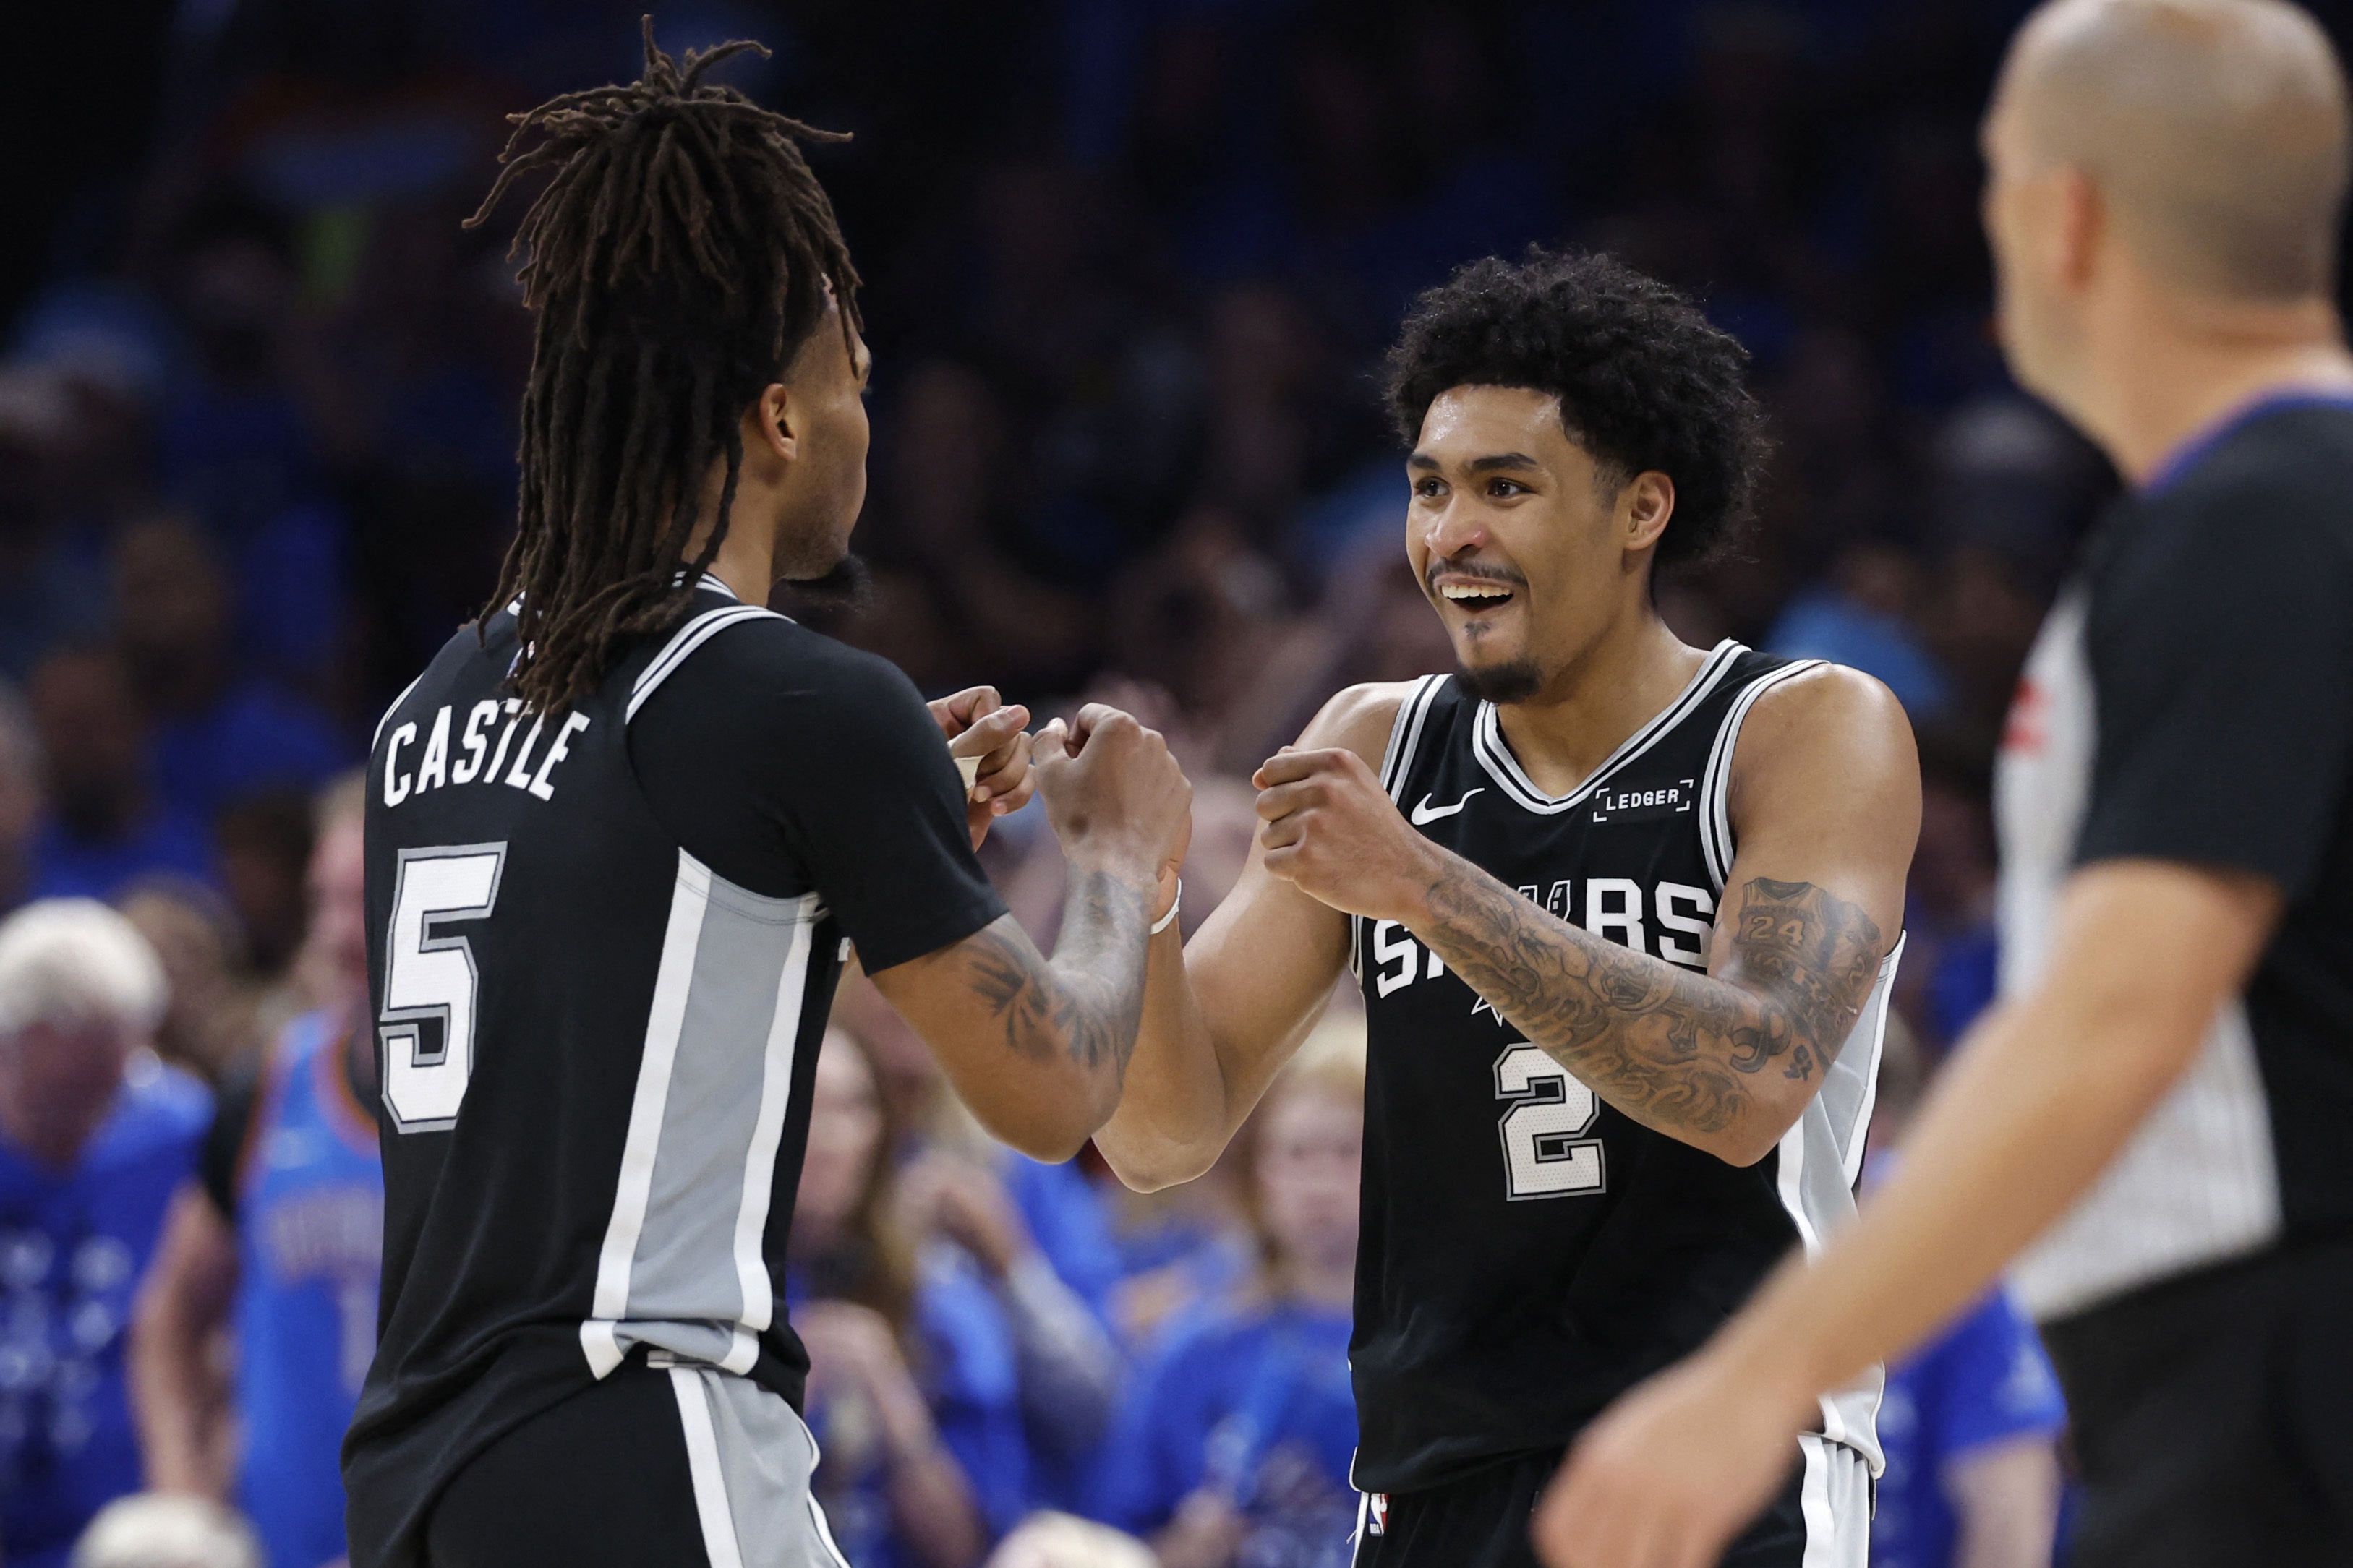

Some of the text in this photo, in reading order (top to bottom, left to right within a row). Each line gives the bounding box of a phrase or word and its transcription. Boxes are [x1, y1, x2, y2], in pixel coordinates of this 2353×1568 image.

[384, 698, 591, 807] CASTLE
[1606, 789, 1679, 810] LEDGER
[380, 841, 507, 1134] 5
[1373, 878, 1715, 998] SRS
[1750, 916, 1805, 946] 24
[1493, 1042, 1606, 1201] 2
